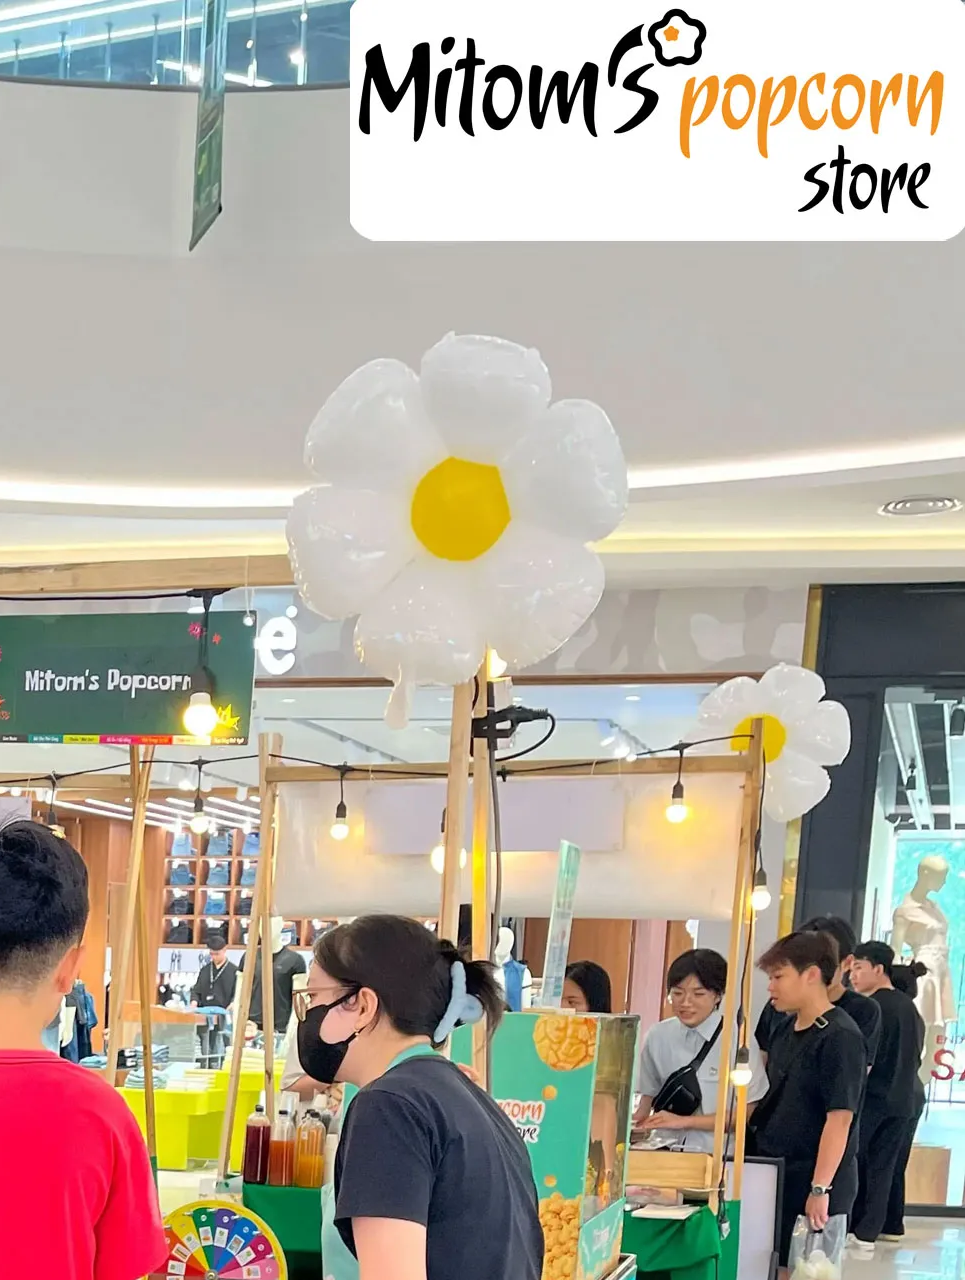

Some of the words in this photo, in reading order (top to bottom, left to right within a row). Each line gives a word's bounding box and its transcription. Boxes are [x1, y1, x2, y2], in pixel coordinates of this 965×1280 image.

[25, 669, 99, 692] Mitom's
[107, 669, 191, 698] Popcorn
[498, 1101, 543, 1121] corn
